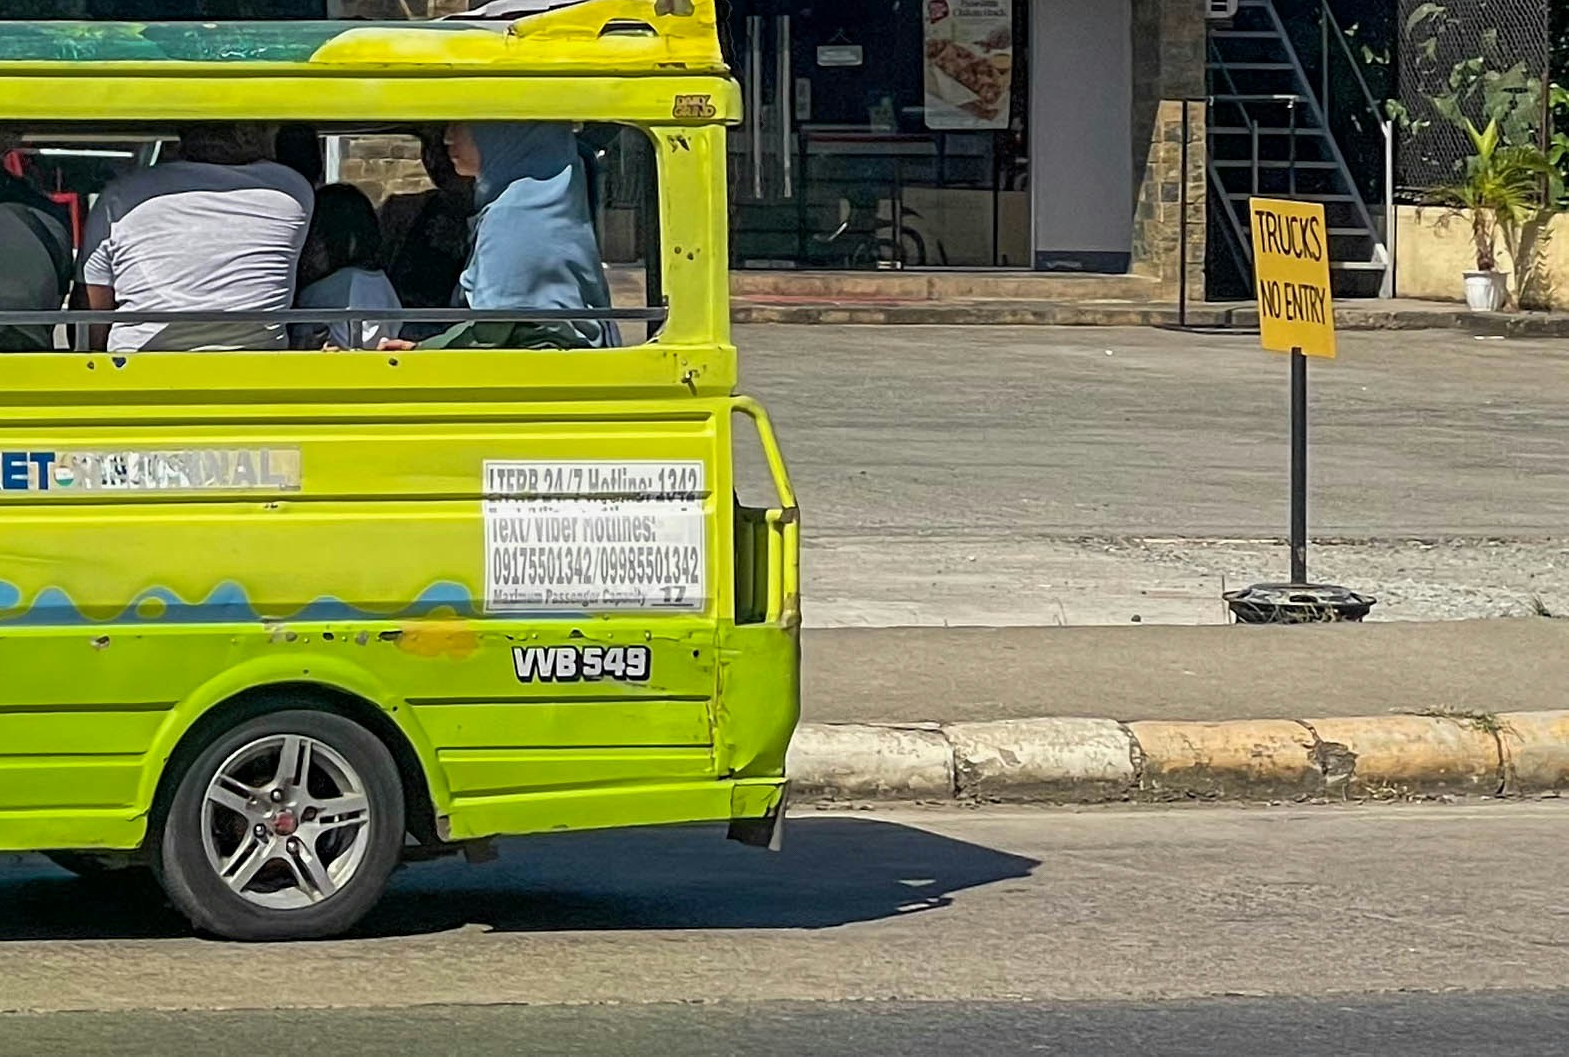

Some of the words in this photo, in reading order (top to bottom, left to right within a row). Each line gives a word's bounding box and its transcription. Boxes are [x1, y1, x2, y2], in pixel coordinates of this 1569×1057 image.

[1254, 210, 1322, 262] TRUCKS
[1260, 279, 1280, 319] NO
[1284, 282, 1326, 325] ENTRY
[493, 546, 698, 585] 09175501342/09985501342
[545, 589, 599, 607] Passenger
[512, 645, 580, 683] VVB
[580, 645, 651, 681] 549
